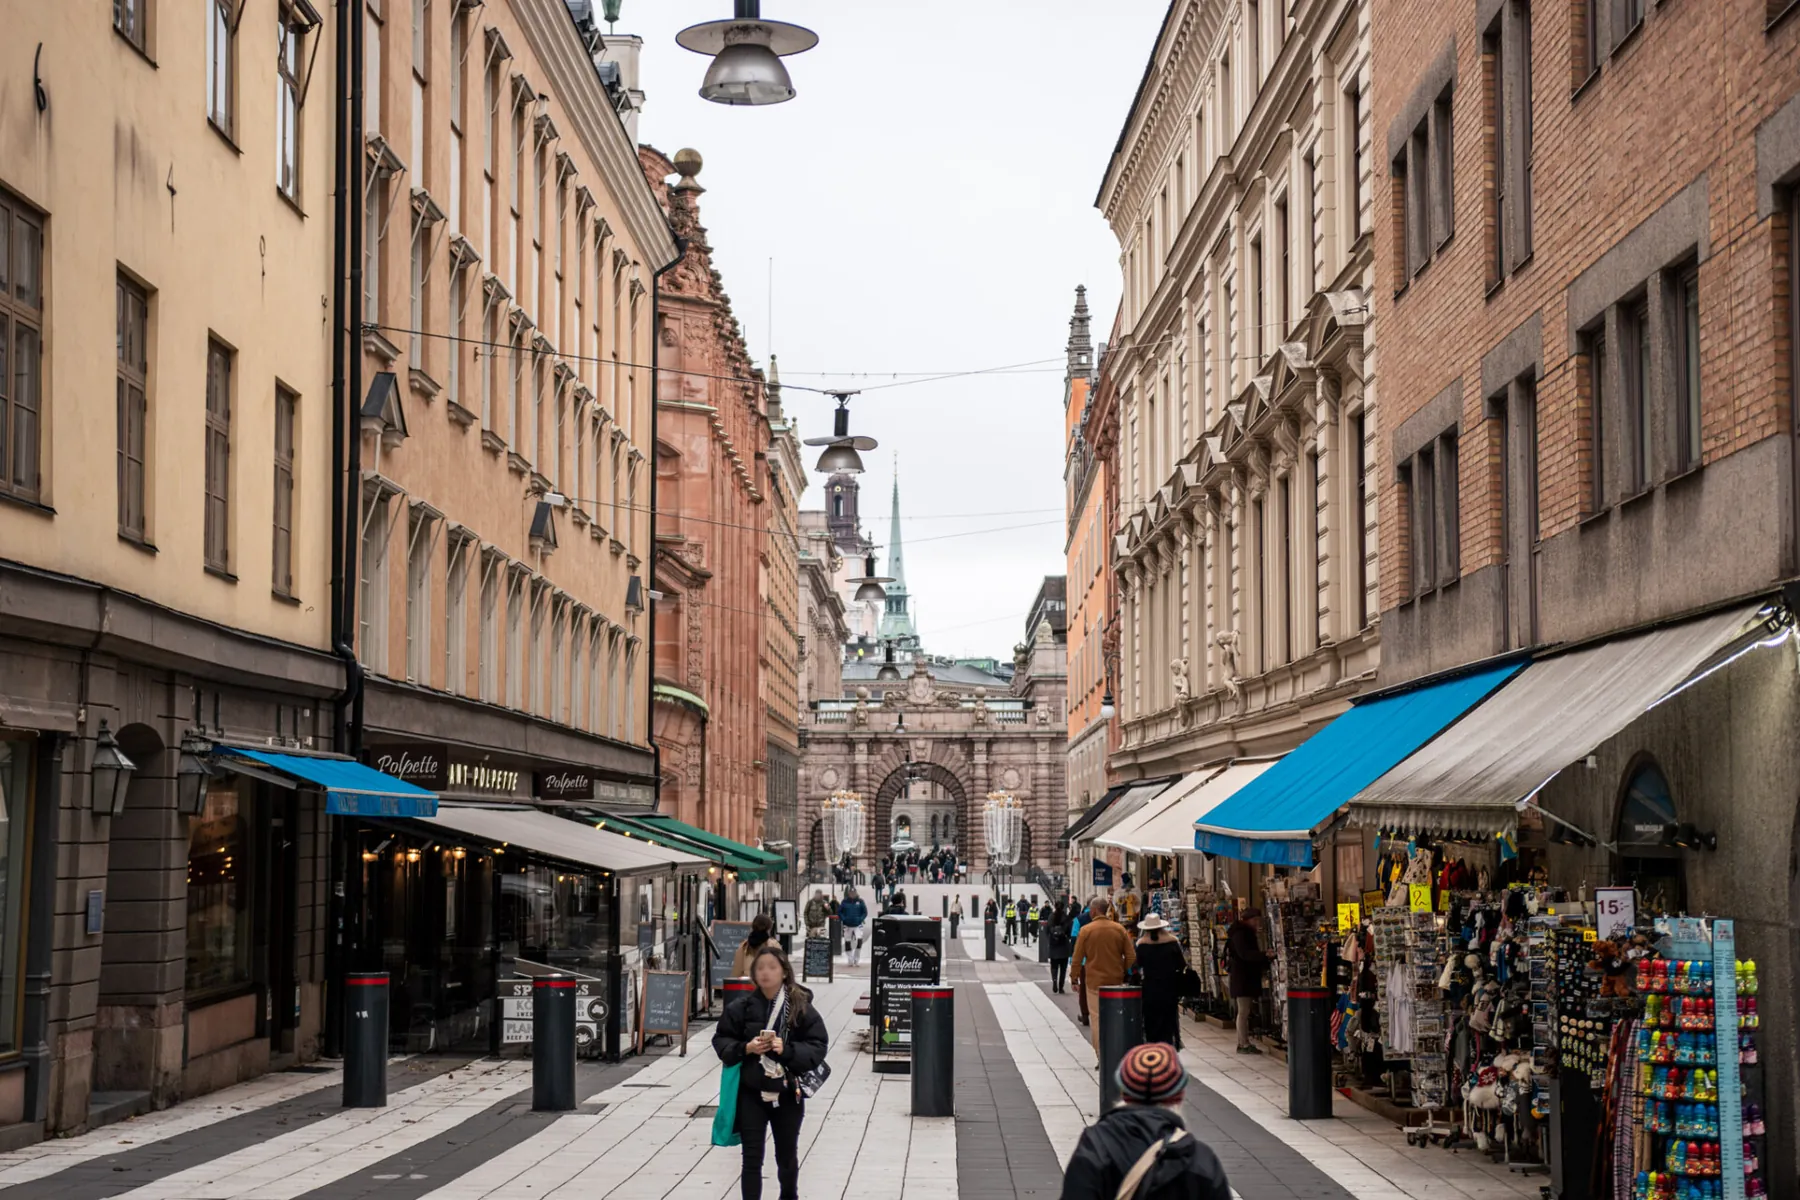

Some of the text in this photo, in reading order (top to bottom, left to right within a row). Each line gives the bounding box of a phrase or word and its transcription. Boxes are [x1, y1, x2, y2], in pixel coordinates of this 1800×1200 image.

[377, 751, 438, 780] Polpette
[545, 772, 588, 795] Polpette
[888, 955, 923, 975] Polpette
